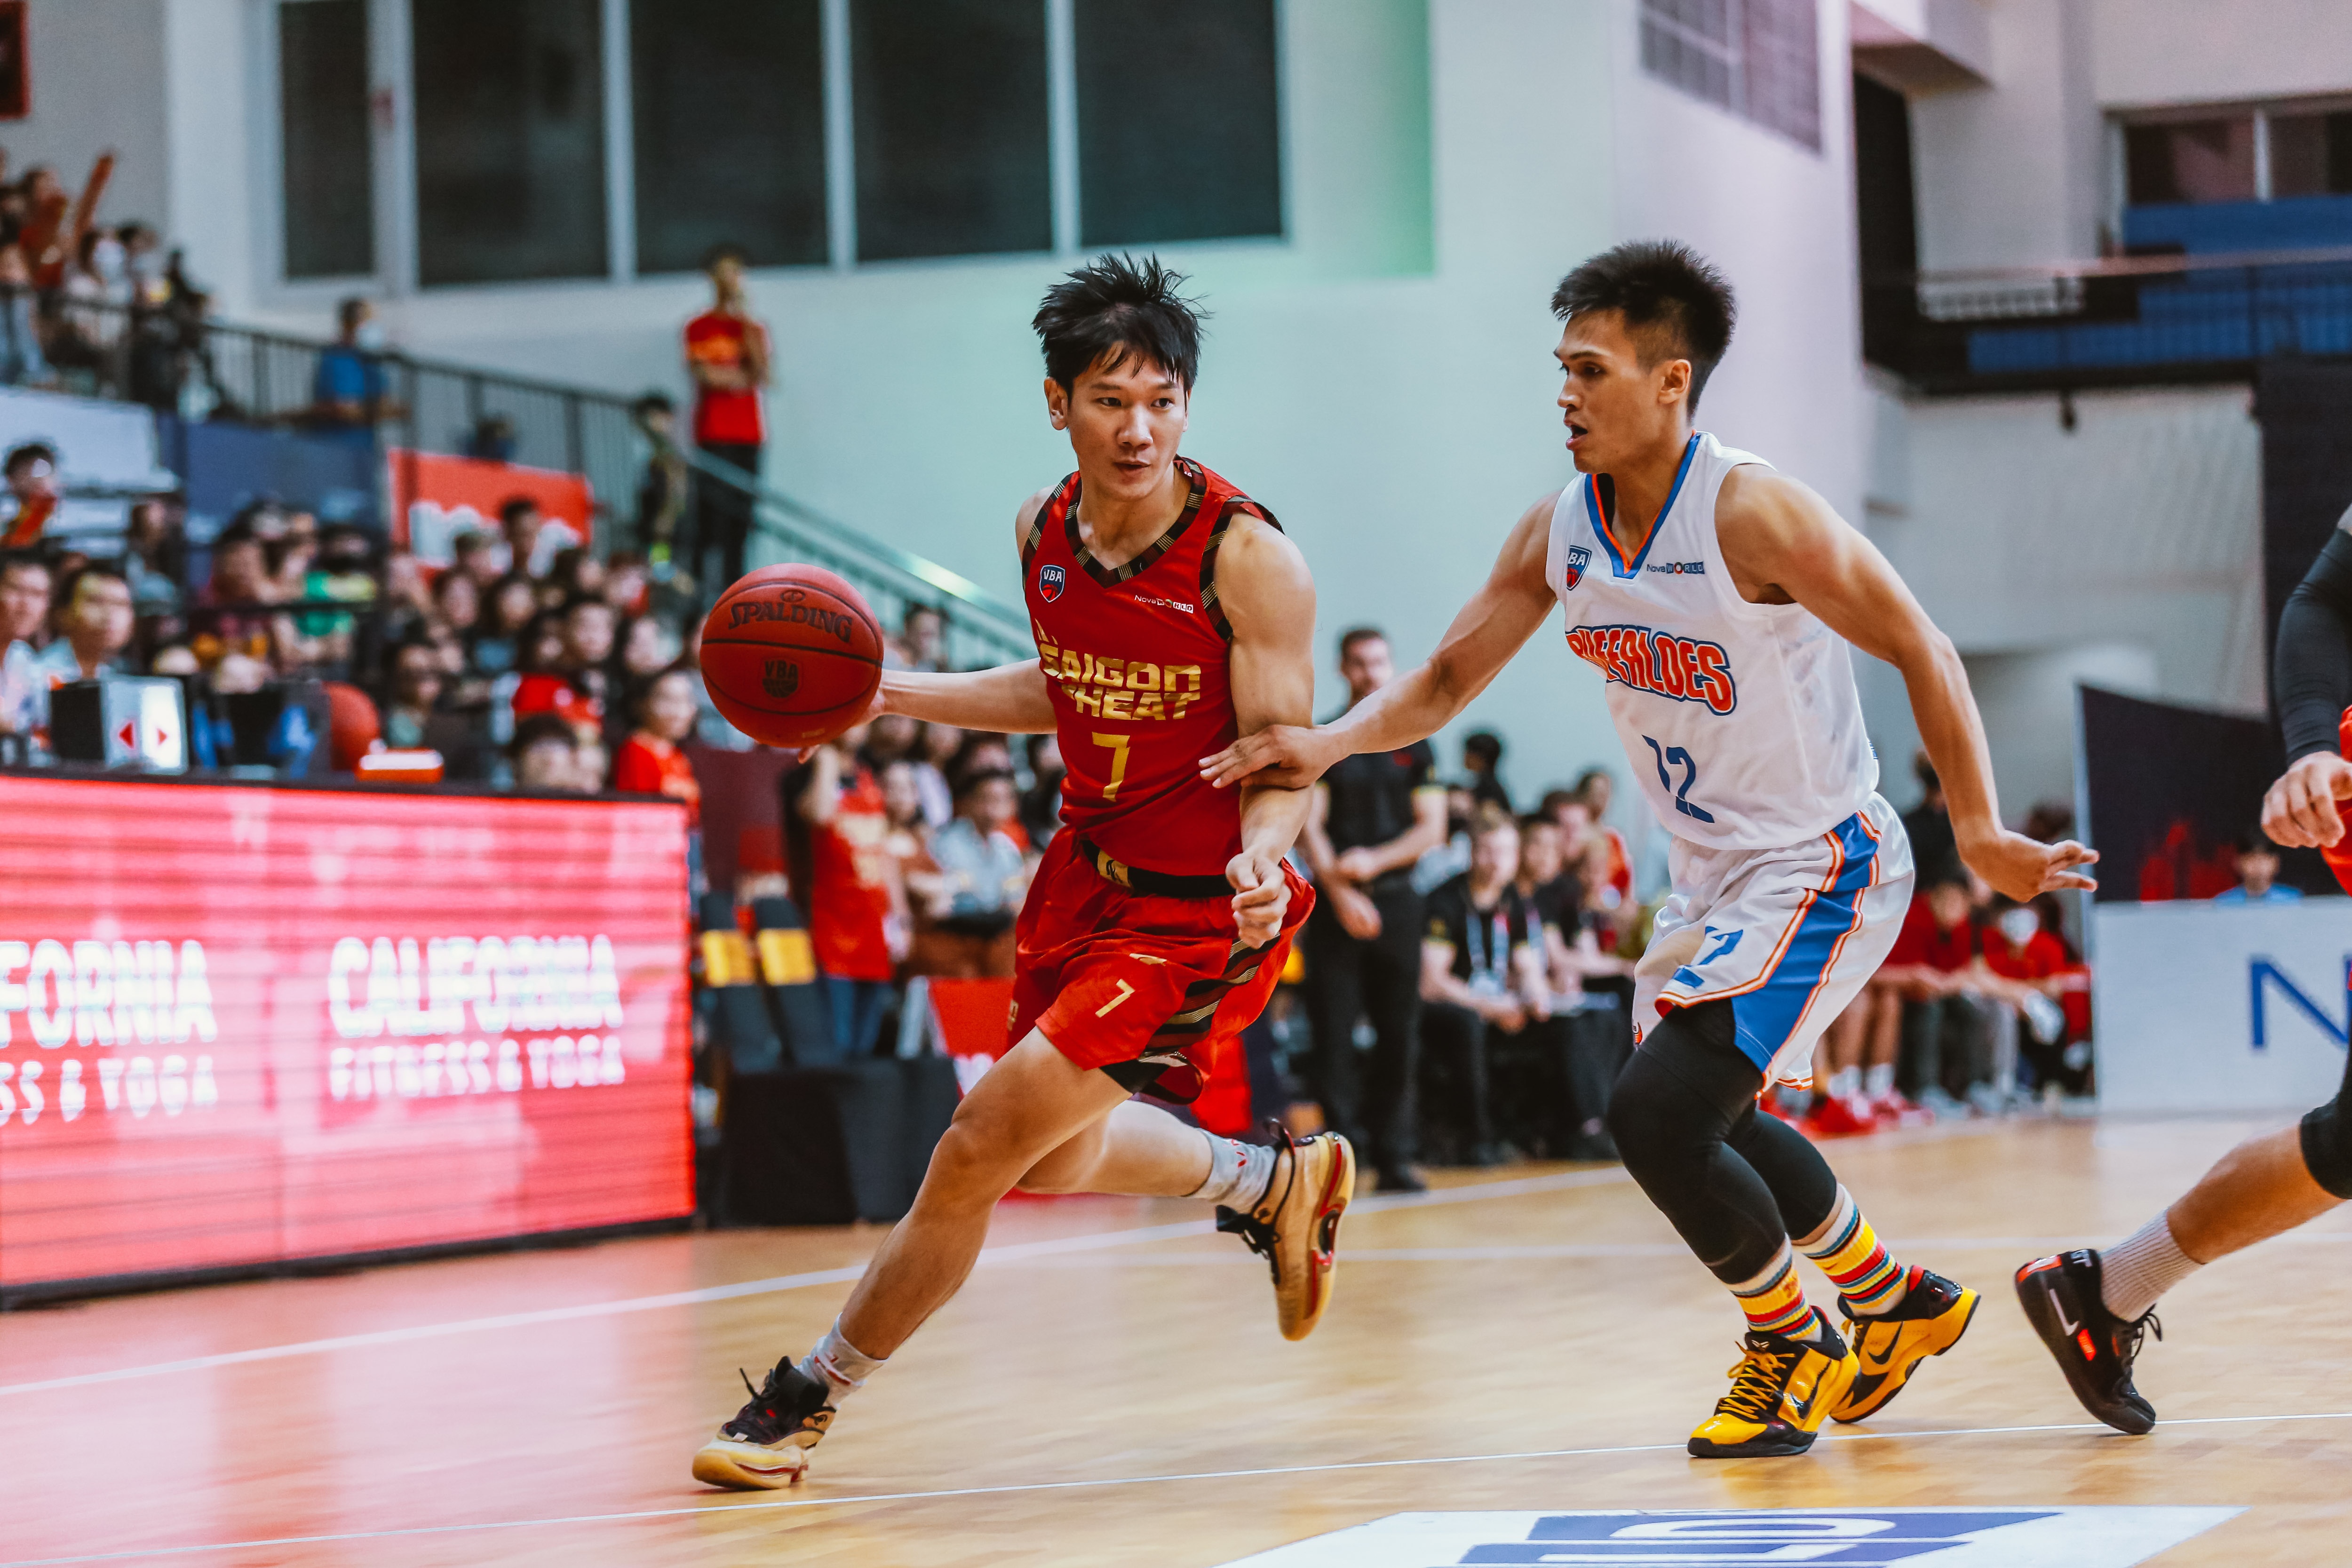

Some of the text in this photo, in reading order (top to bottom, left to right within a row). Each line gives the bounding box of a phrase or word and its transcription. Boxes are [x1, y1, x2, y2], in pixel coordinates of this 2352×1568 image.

[1044, 569, 1062, 582] VBA
[1568, 552, 1586, 566] BA
[728, 601, 853, 643] SPALDING
[763, 659, 799, 680] VBA
[1039, 642, 1201, 691] SAIGON
[1565, 624, 1737, 716] BUFFALOES
[1070, 685, 1200, 721] HEAT
[1092, 732, 1130, 802] 7
[1642, 734, 1715, 823] 12
[328, 934, 624, 1038] CALIFORNIA
[1095, 978, 1135, 1019] 7
[97, 1055, 219, 1118] YOGA
[330, 1041, 492, 1100] FITNESS
[527, 1035, 625, 1088] YOGA
